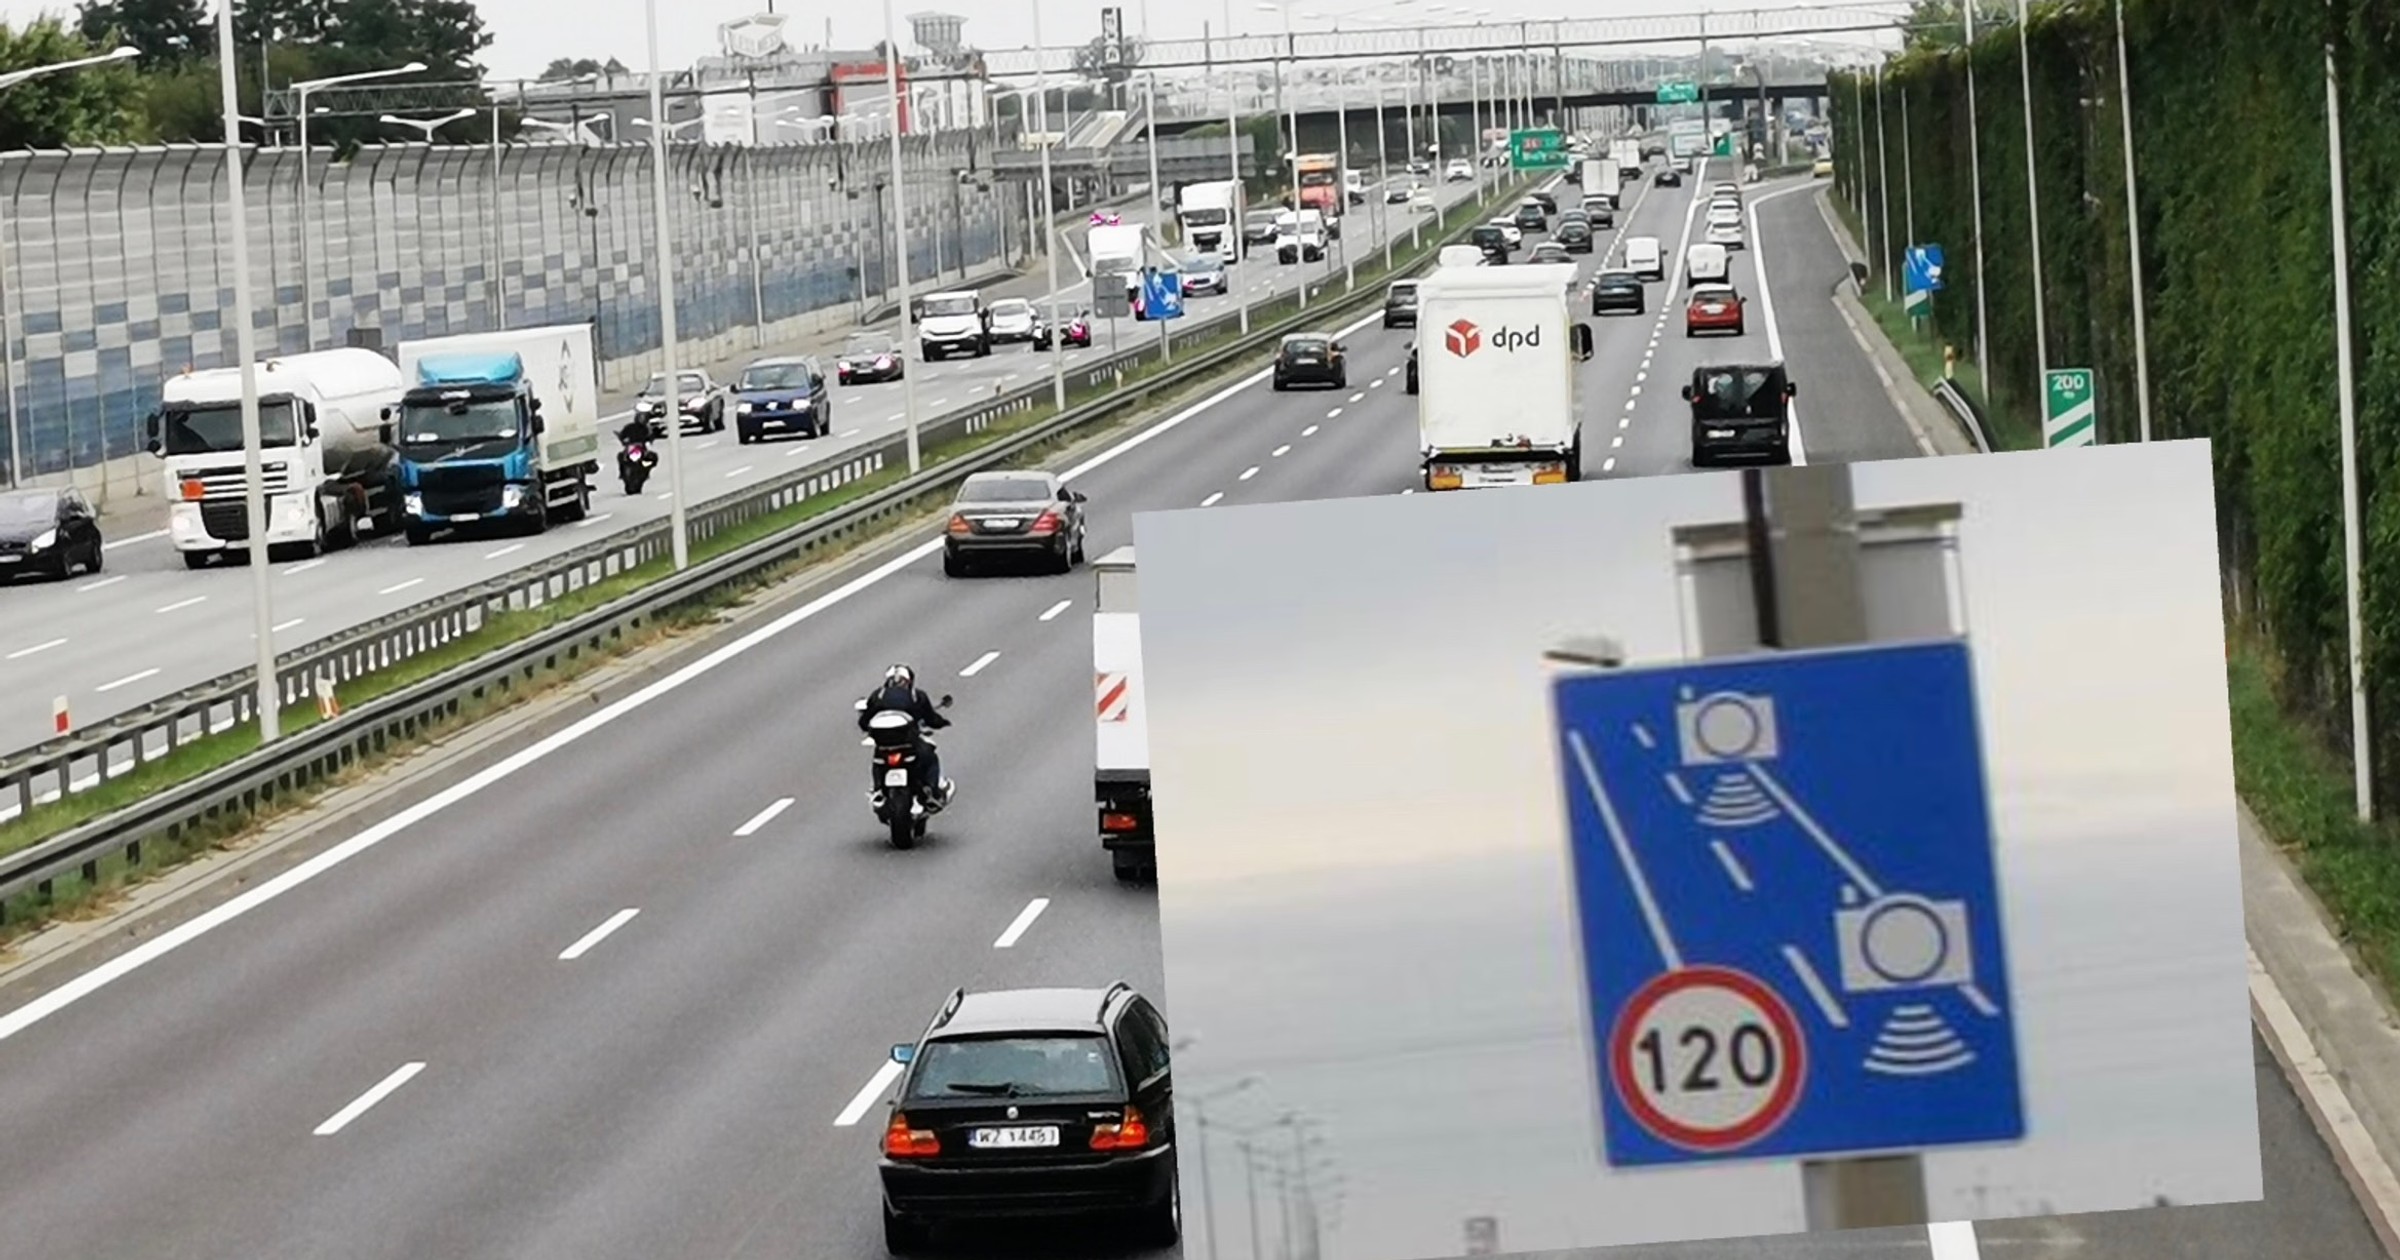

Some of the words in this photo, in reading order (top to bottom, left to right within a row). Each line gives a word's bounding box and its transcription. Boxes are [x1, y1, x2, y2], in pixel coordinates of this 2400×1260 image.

[1491, 323, 1540, 353] dpd
[2052, 374, 2085, 391] 200
[1638, 1023, 1776, 1093] 120
